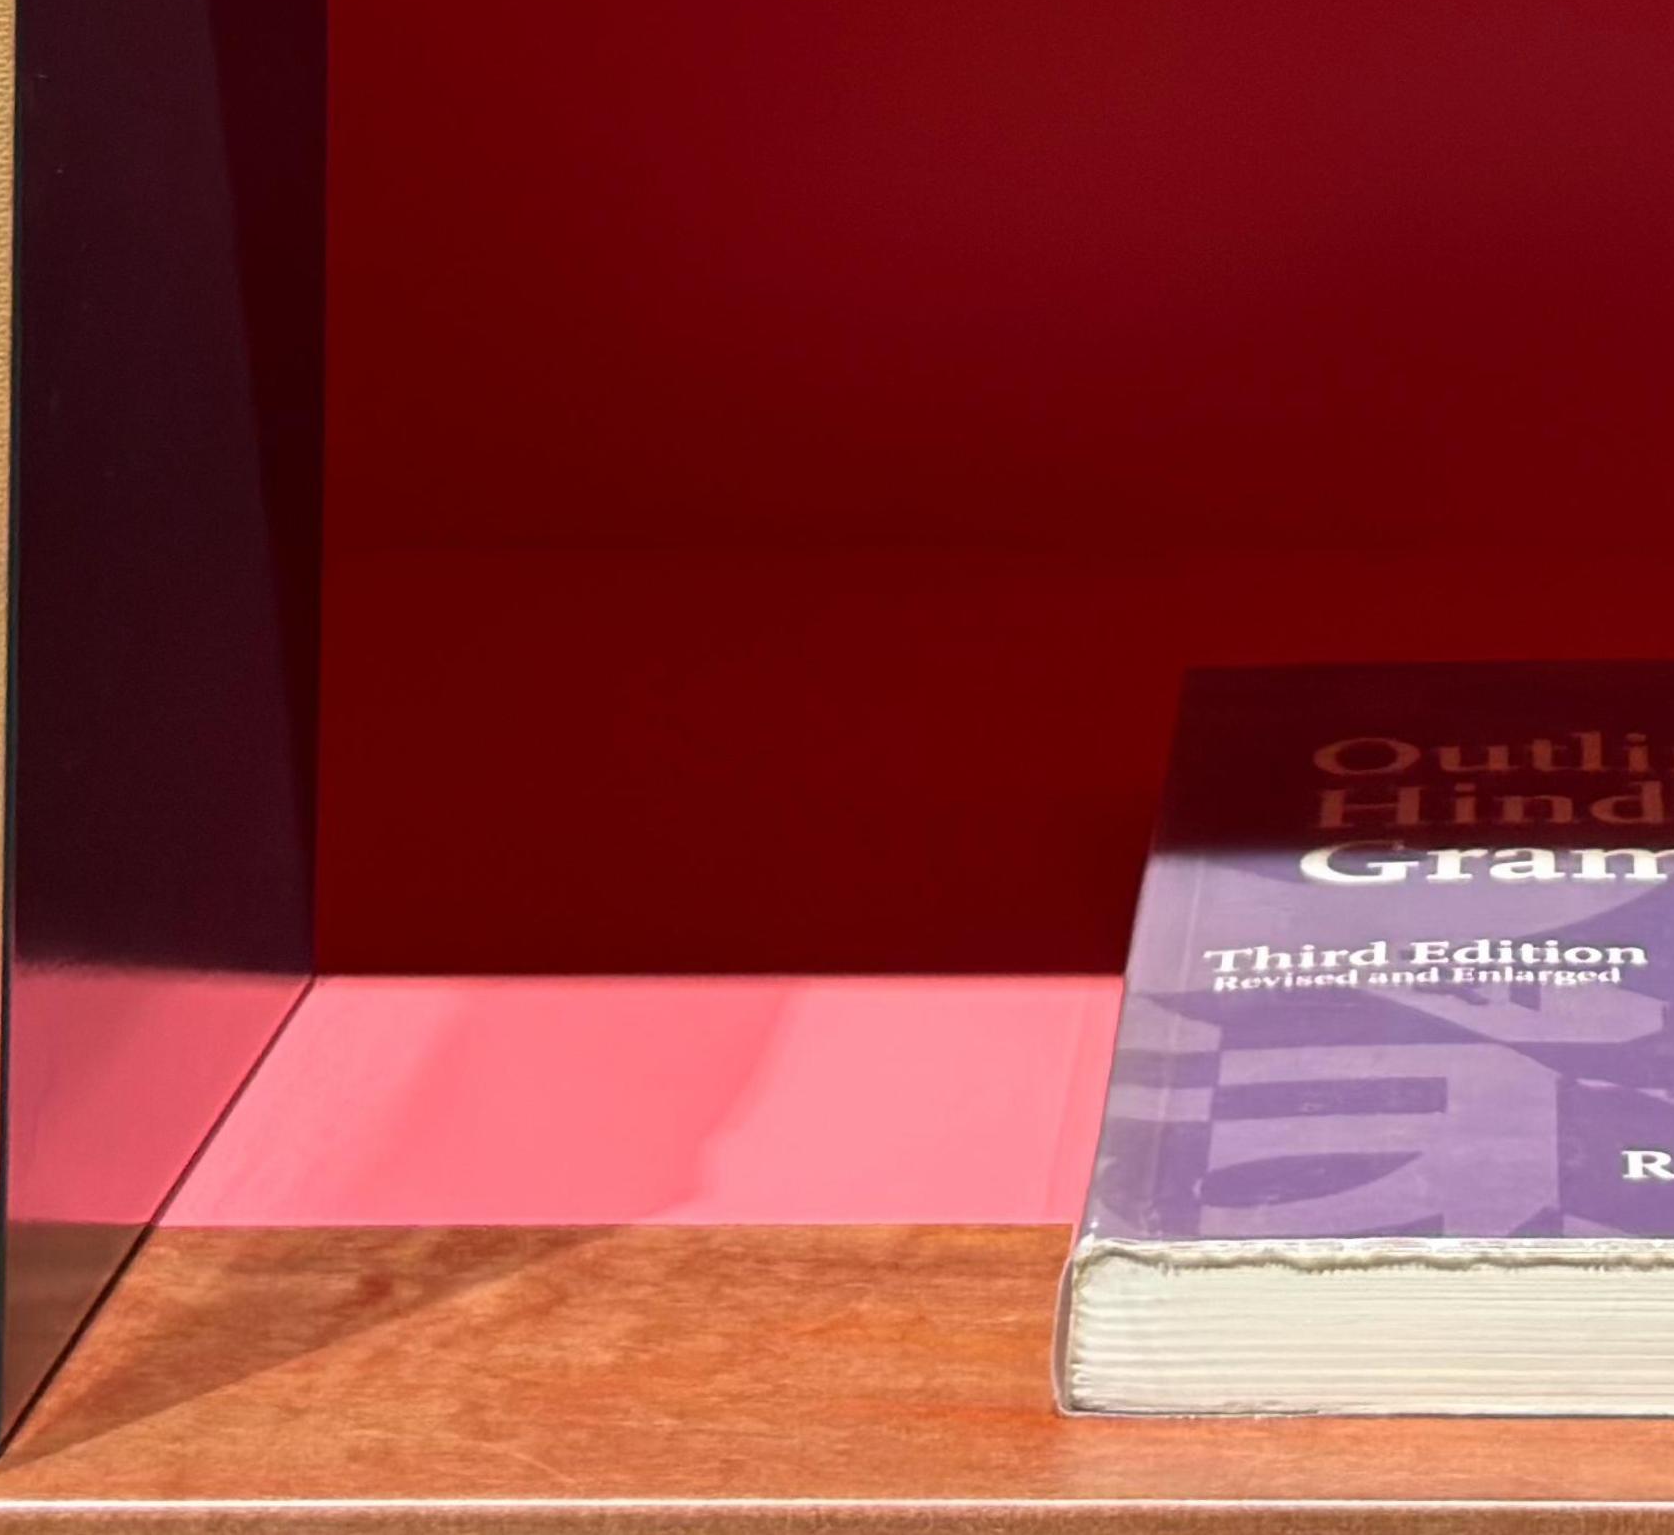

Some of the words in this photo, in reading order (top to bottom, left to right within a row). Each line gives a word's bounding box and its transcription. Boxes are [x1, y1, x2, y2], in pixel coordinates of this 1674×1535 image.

[1202, 940, 1390, 972] Third
[1406, 939, 1648, 966] Edition
[1211, 969, 1360, 992] Revised
[1368, 966, 1440, 986] and
[1450, 964, 1624, 988] Enlarged
